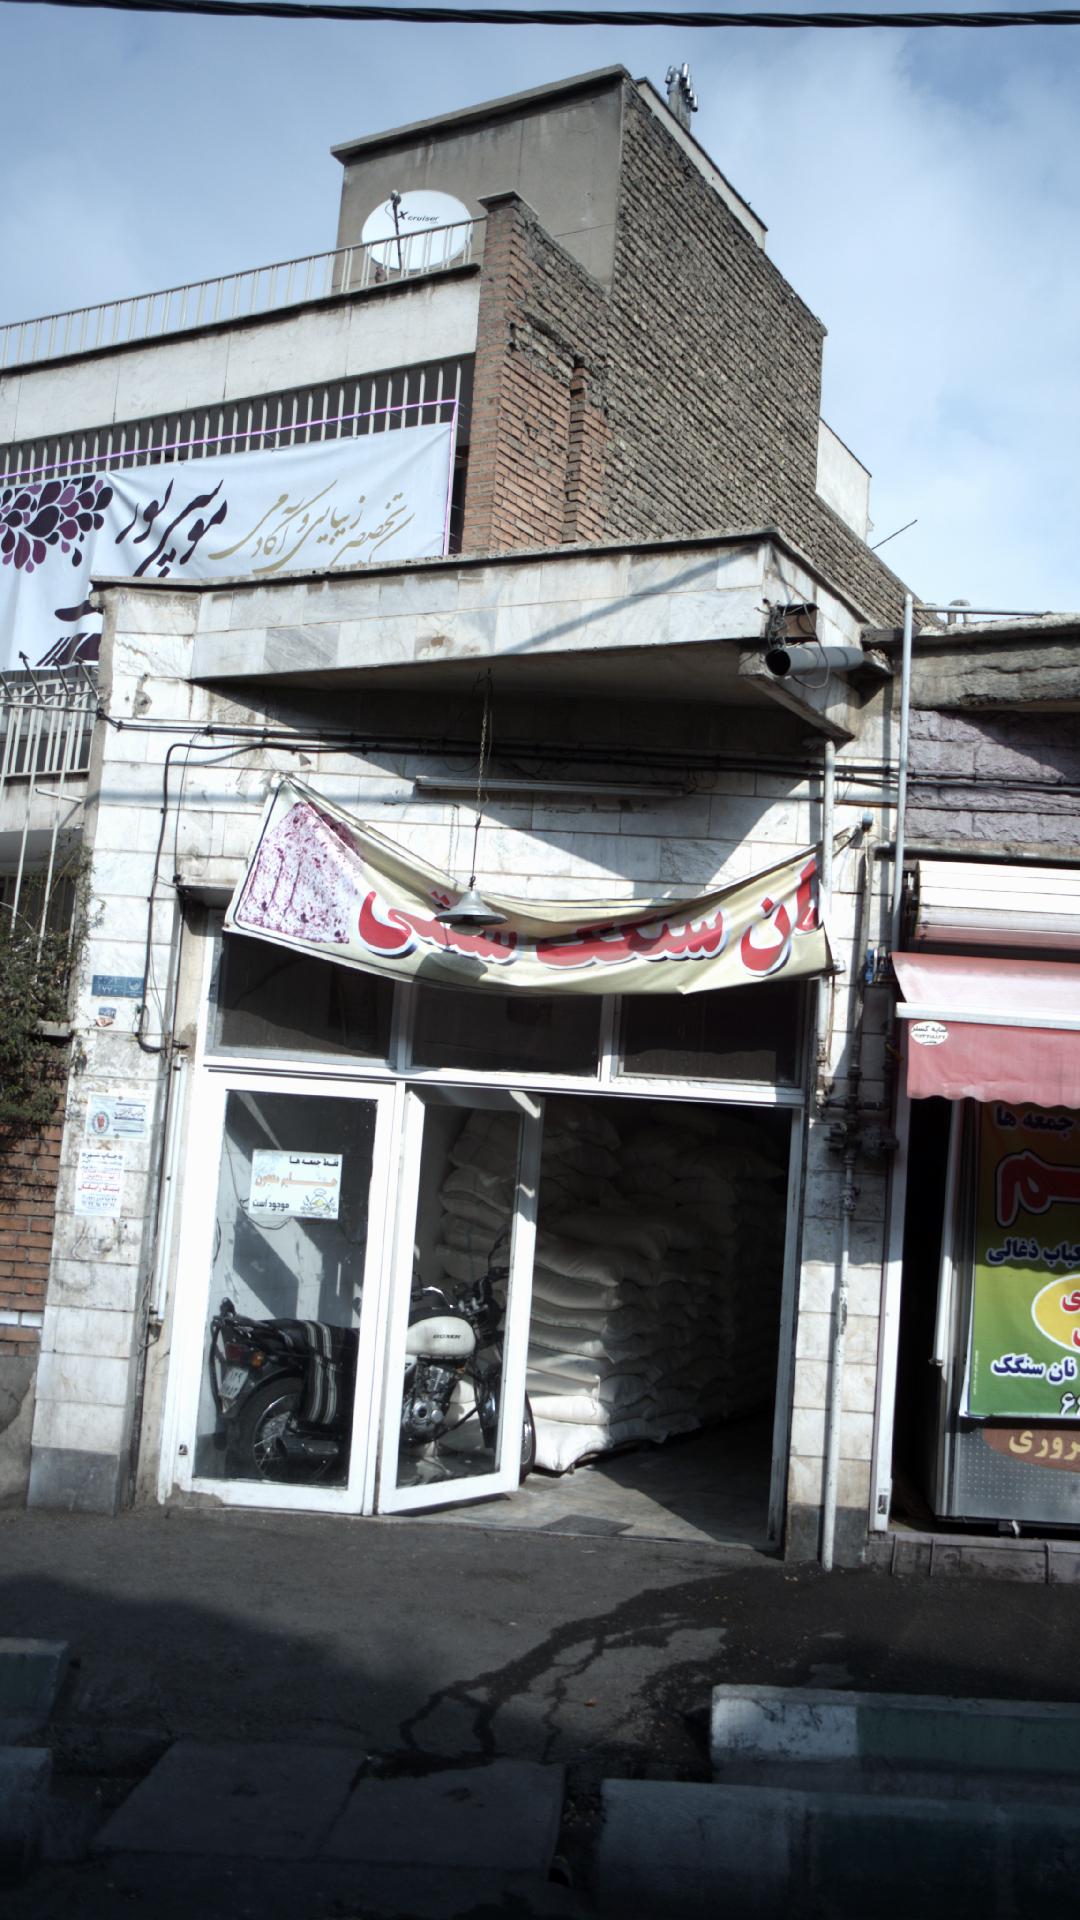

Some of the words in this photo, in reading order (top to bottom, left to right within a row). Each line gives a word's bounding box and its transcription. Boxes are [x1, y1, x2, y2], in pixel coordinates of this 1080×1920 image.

[996, 1104, 1017, 1127] ها
[1023, 1112, 1074, 1138] جمعه
[988, 1238, 1039, 1263] ذغالی
[992, 1355, 1044, 1376] سنگک
[1050, 1357, 1076, 1382] نان
[1008, 1430, 1080, 1460] روری
